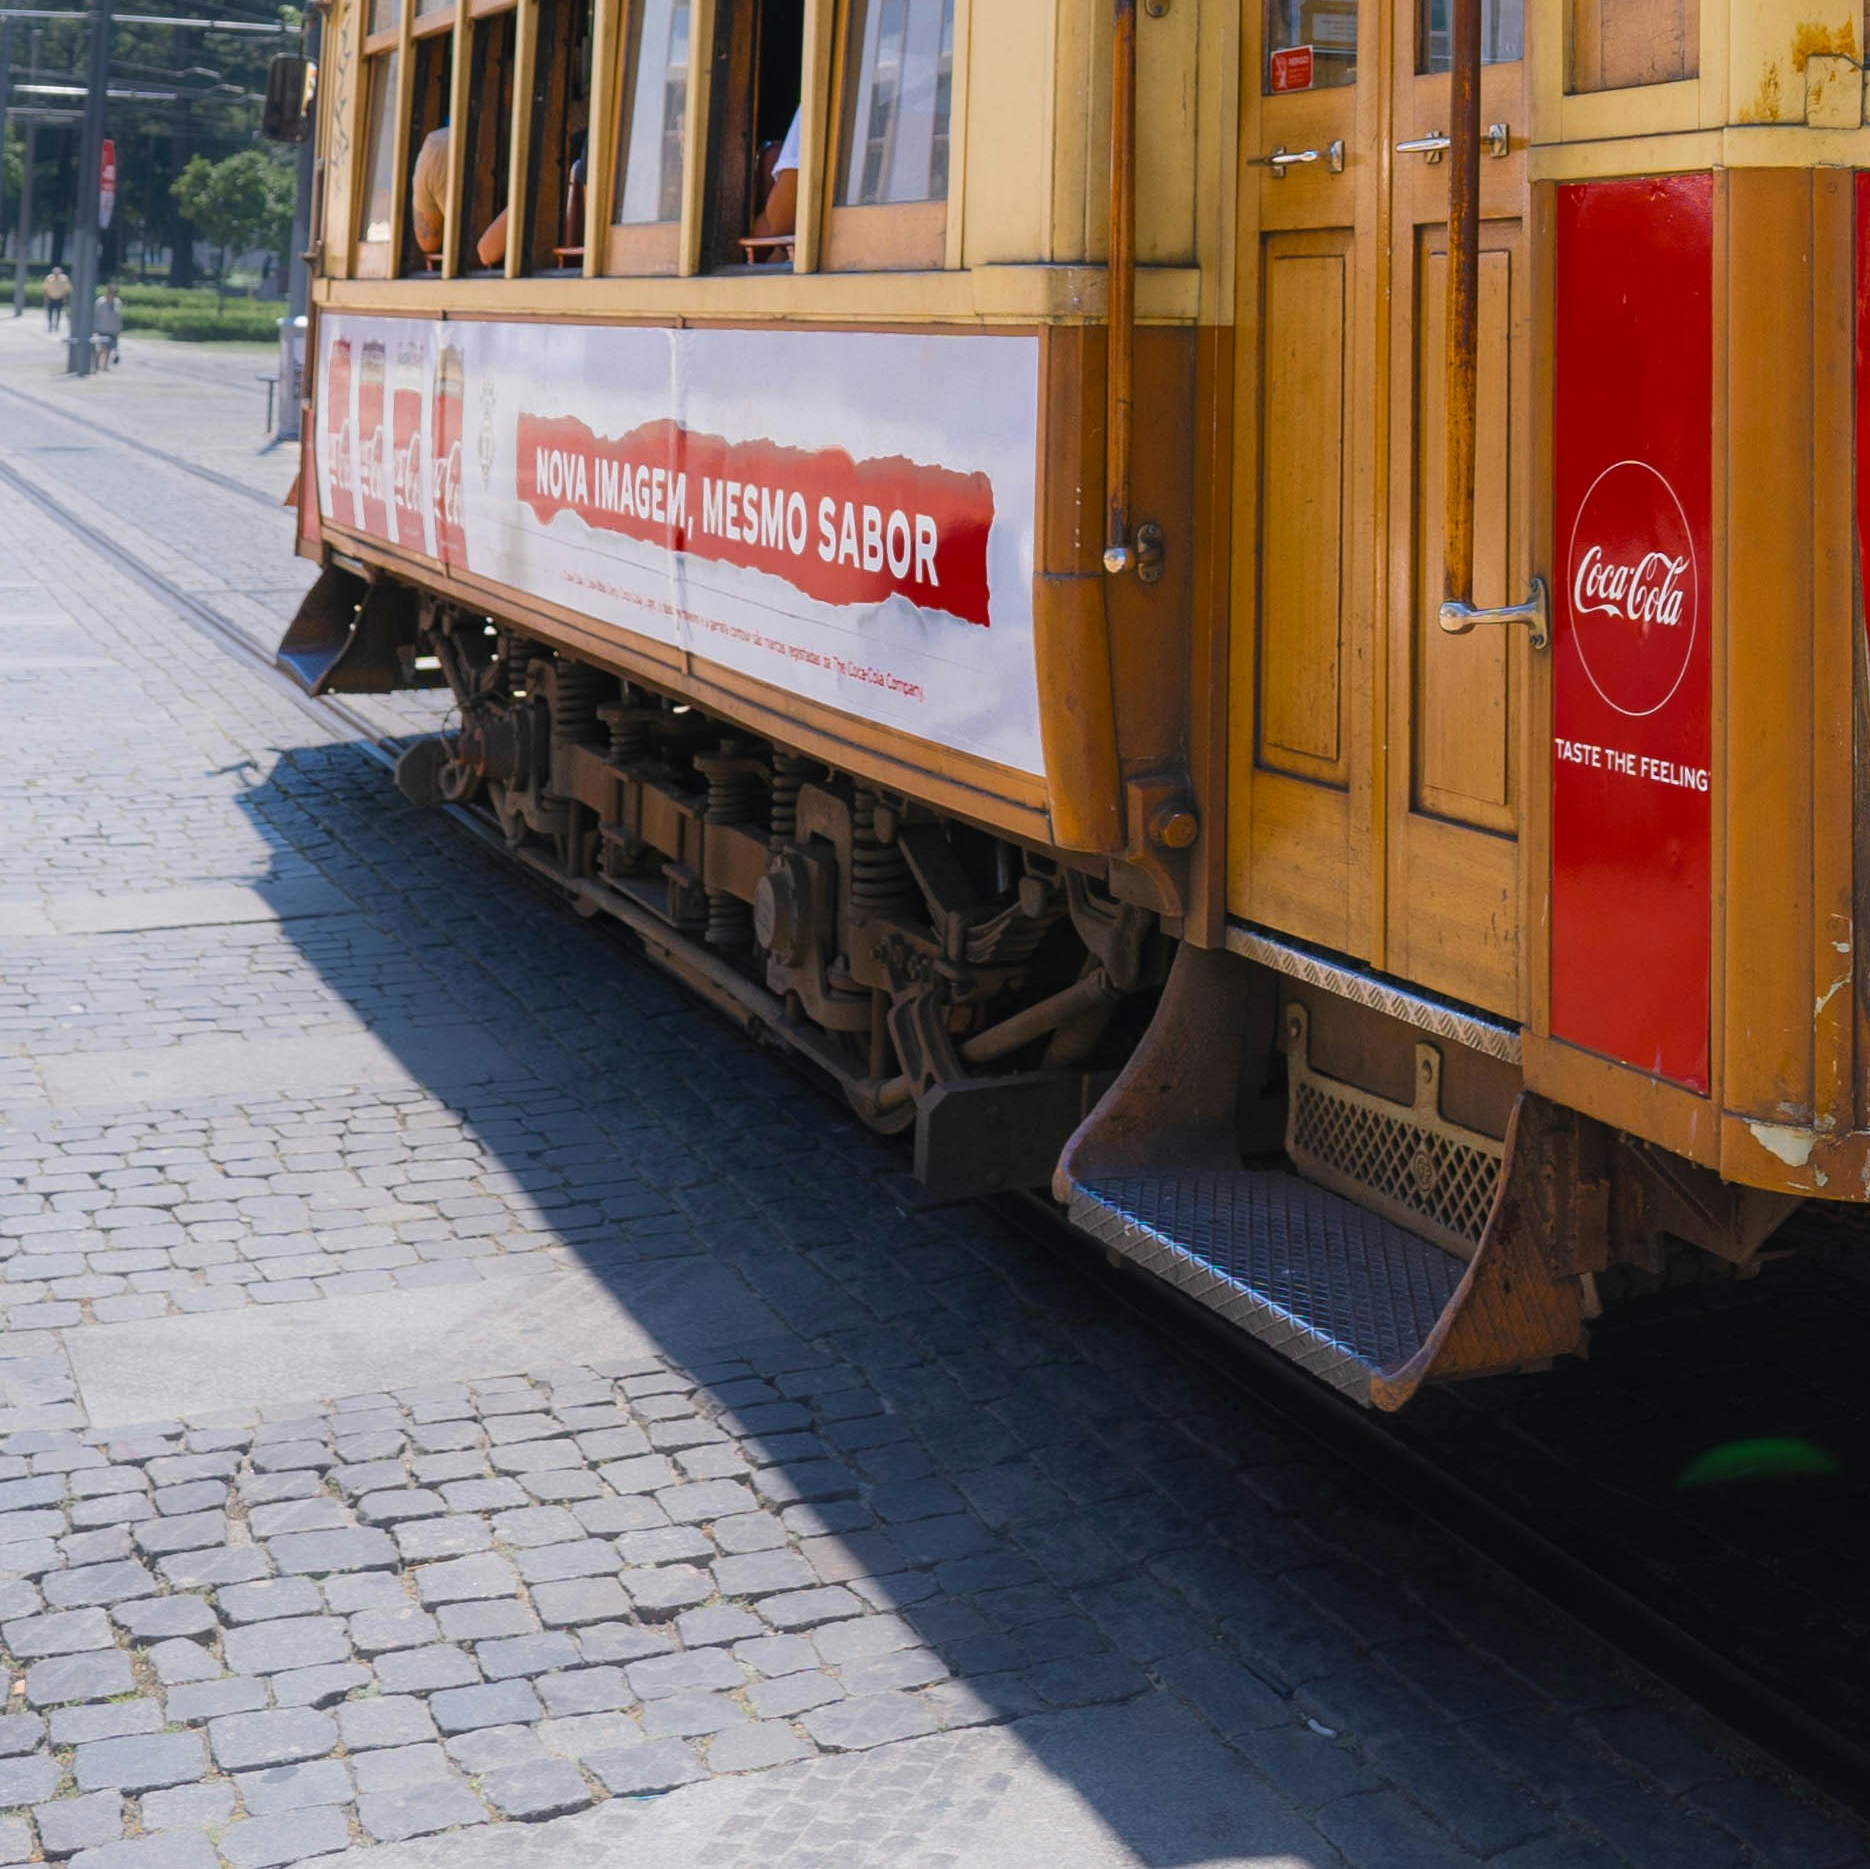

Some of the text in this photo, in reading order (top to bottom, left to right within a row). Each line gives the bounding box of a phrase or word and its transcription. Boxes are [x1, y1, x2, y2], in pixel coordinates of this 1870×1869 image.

[536, 446, 589, 506] NOVA
[594, 457, 694, 542] IMAGEM,
[702, 476, 808, 556] MESMO
[817, 496, 940, 587] SABOR
[1574, 545, 1691, 627] Coca-Cola
[1554, 737, 1709, 793] TASTE THE FEELING
